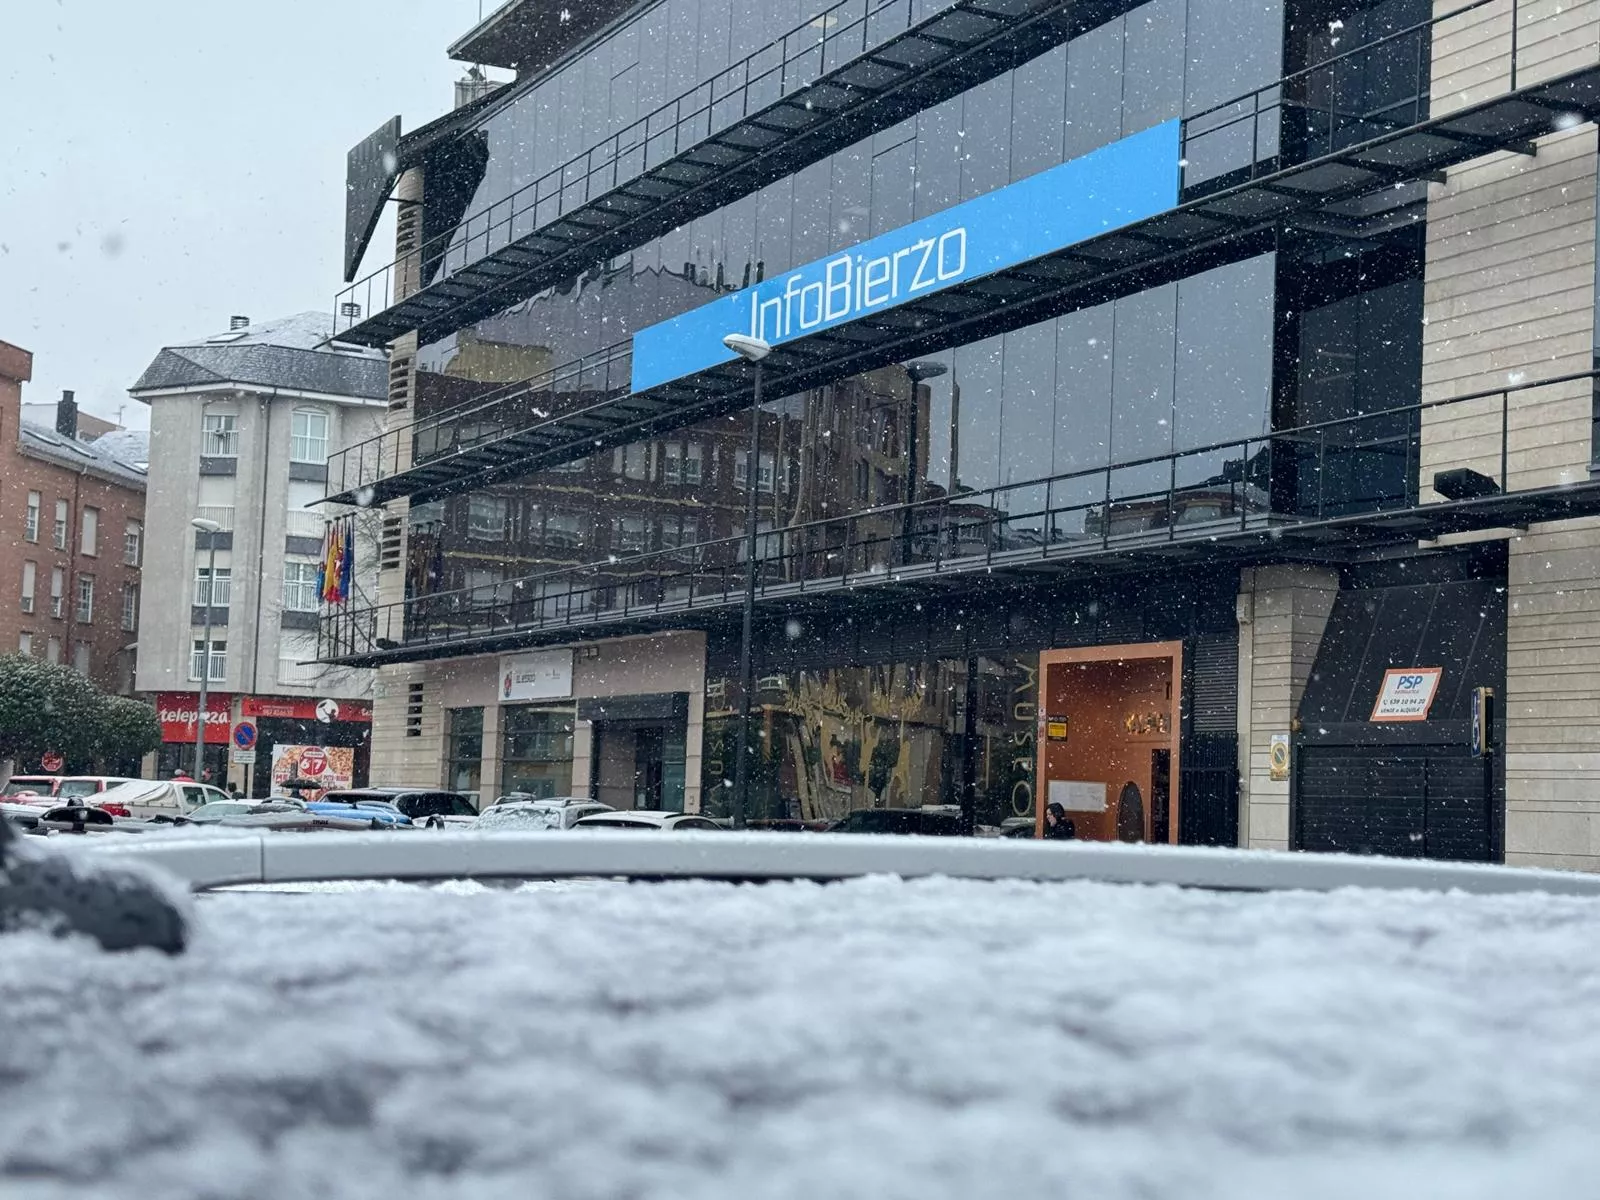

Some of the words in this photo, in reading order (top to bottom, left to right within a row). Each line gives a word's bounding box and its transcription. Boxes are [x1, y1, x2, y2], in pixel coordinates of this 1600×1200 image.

[751, 227, 966, 340] InfoBierzo
[1397, 675, 1423, 689] PSP
[158, 708, 228, 727] telepzza
[1012, 661, 1038, 816] MUSEO
